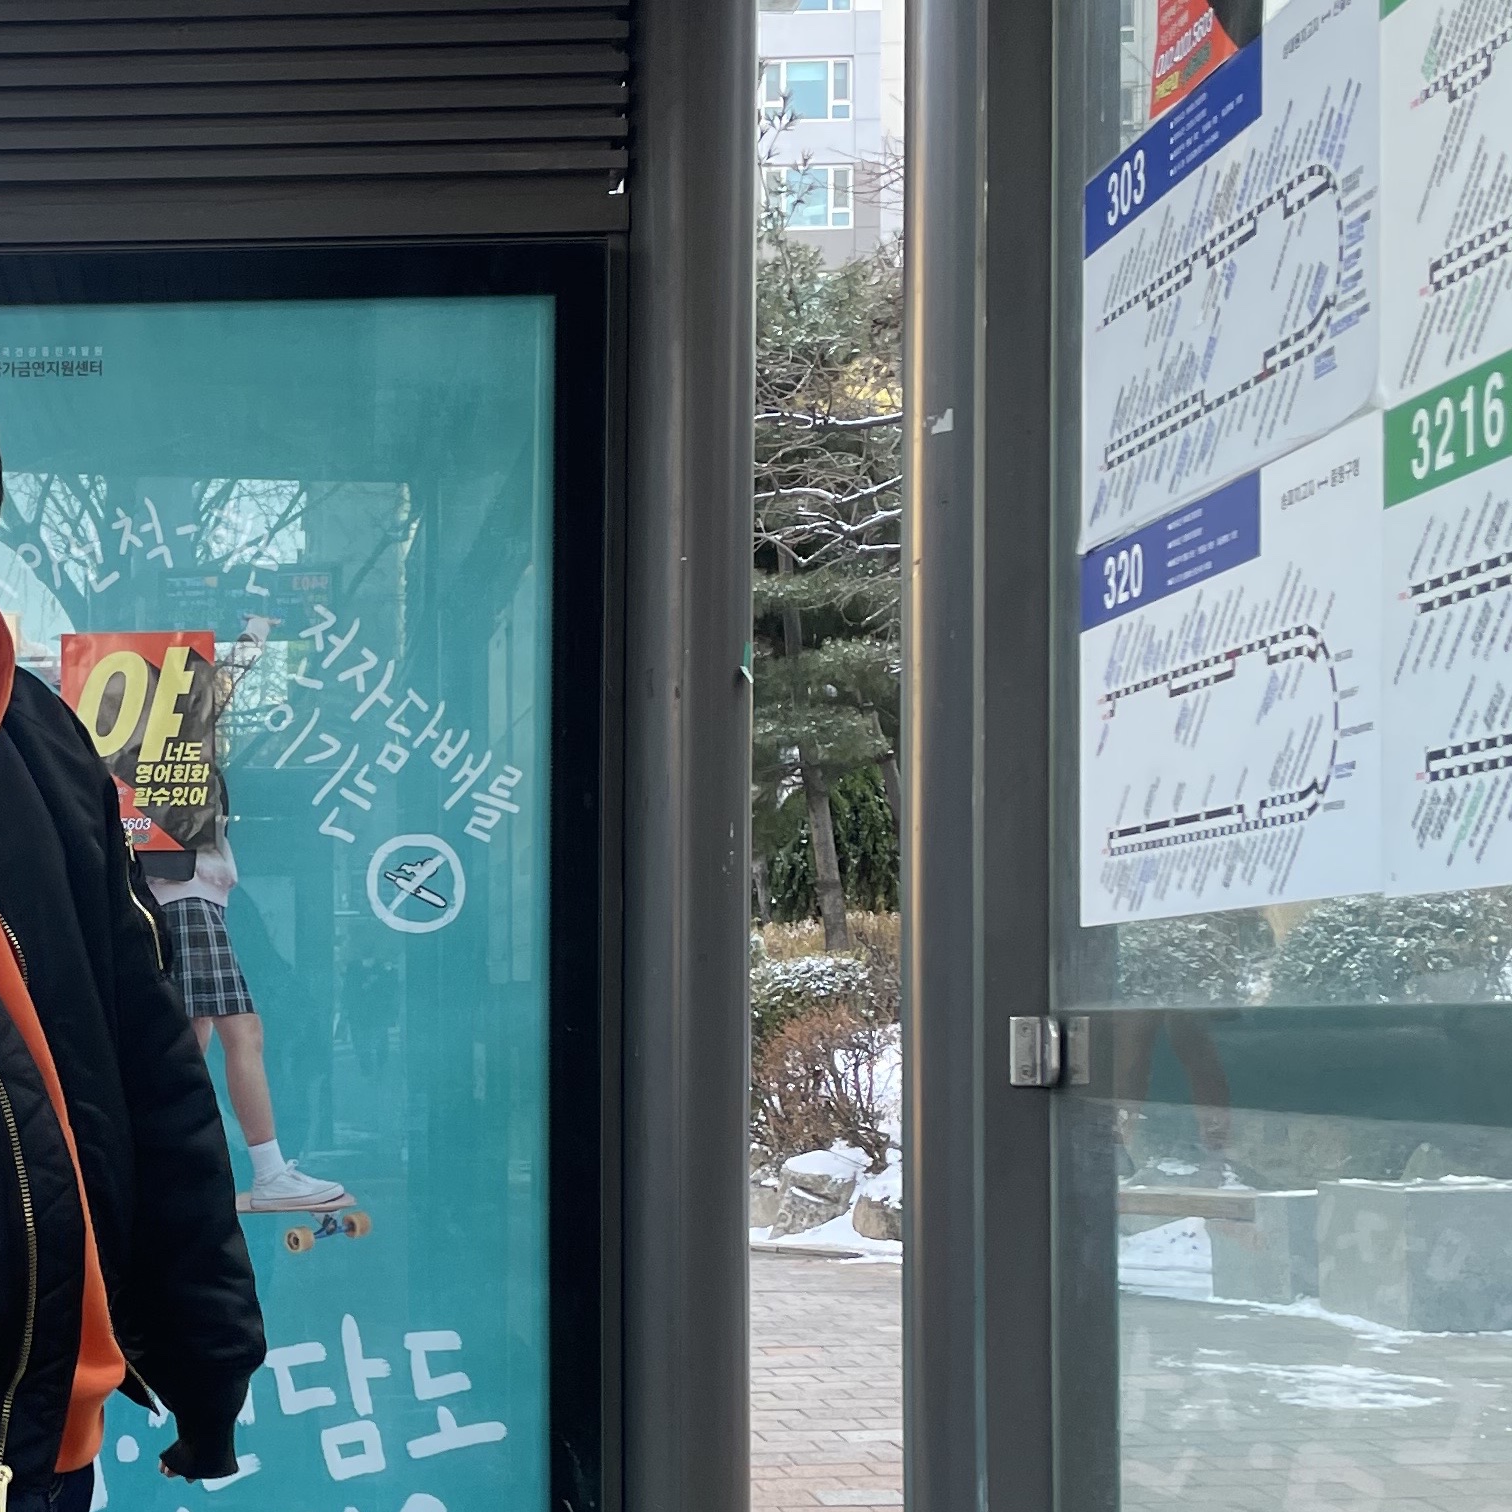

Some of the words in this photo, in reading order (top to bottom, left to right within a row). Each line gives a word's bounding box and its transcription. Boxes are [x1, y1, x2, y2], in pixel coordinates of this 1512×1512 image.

[1107, 149, 1146, 226] 303
[1410, 371, 1506, 480] 3216
[1103, 543, 1144, 610] 320
[76, 646, 196, 763] 야
[290, 603, 524, 844] 전자담배를
[135, 763, 210, 784] 영어회화
[164, 742, 203, 762] 너도
[264, 705, 383, 844] 이기는
[132, 786, 209, 807] 할수있어
